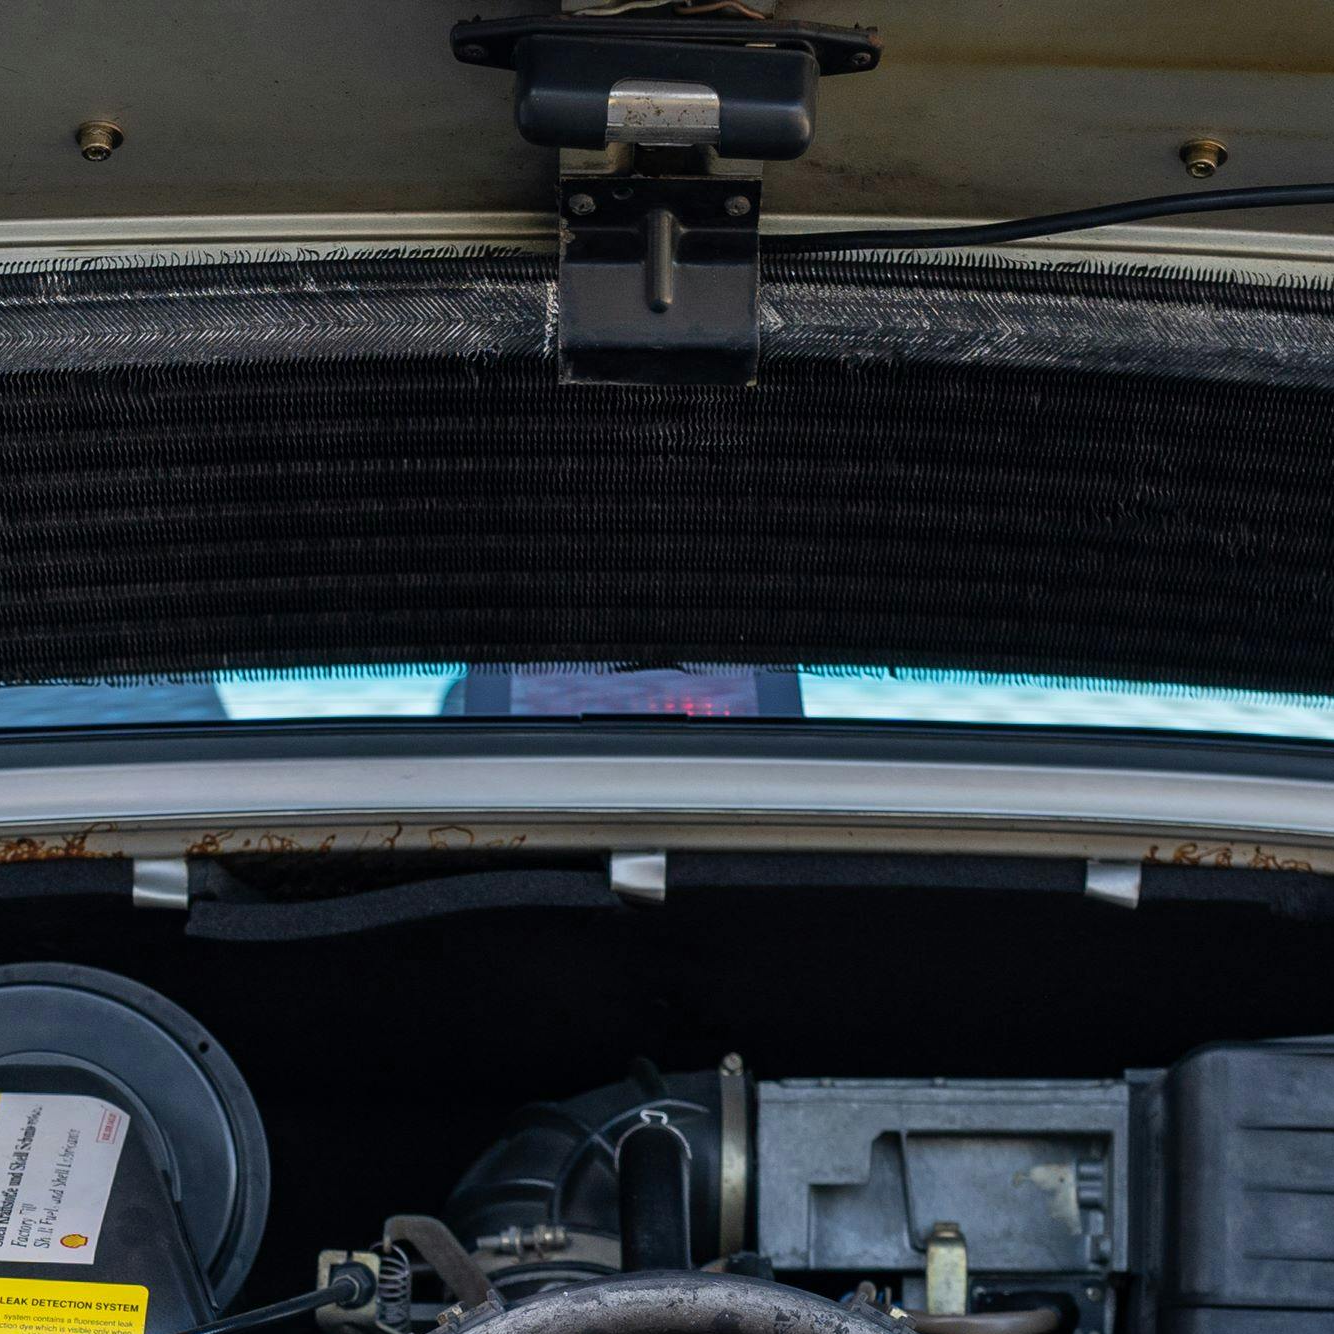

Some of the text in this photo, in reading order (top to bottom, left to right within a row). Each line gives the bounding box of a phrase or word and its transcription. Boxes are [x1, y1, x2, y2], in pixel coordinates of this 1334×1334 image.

[10, 1149, 29, 1171] Shell
[8, 1171, 23, 1188] und
[52, 1167, 69, 1189] Shell
[11, 1218, 36, 1248] Factory
[0, 1296, 28, 1305] LEAK
[31, 1298, 92, 1310] DETECTION
[95, 1302, 139, 1312] SYSTEM
[3, 1313, 31, 1322] system
[32, 1315, 65, 1323] contains
[73, 1317, 116, 1327] fluorescent
[19, 1323, 34, 1331] dye
[35, 1324, 58, 1332] which
